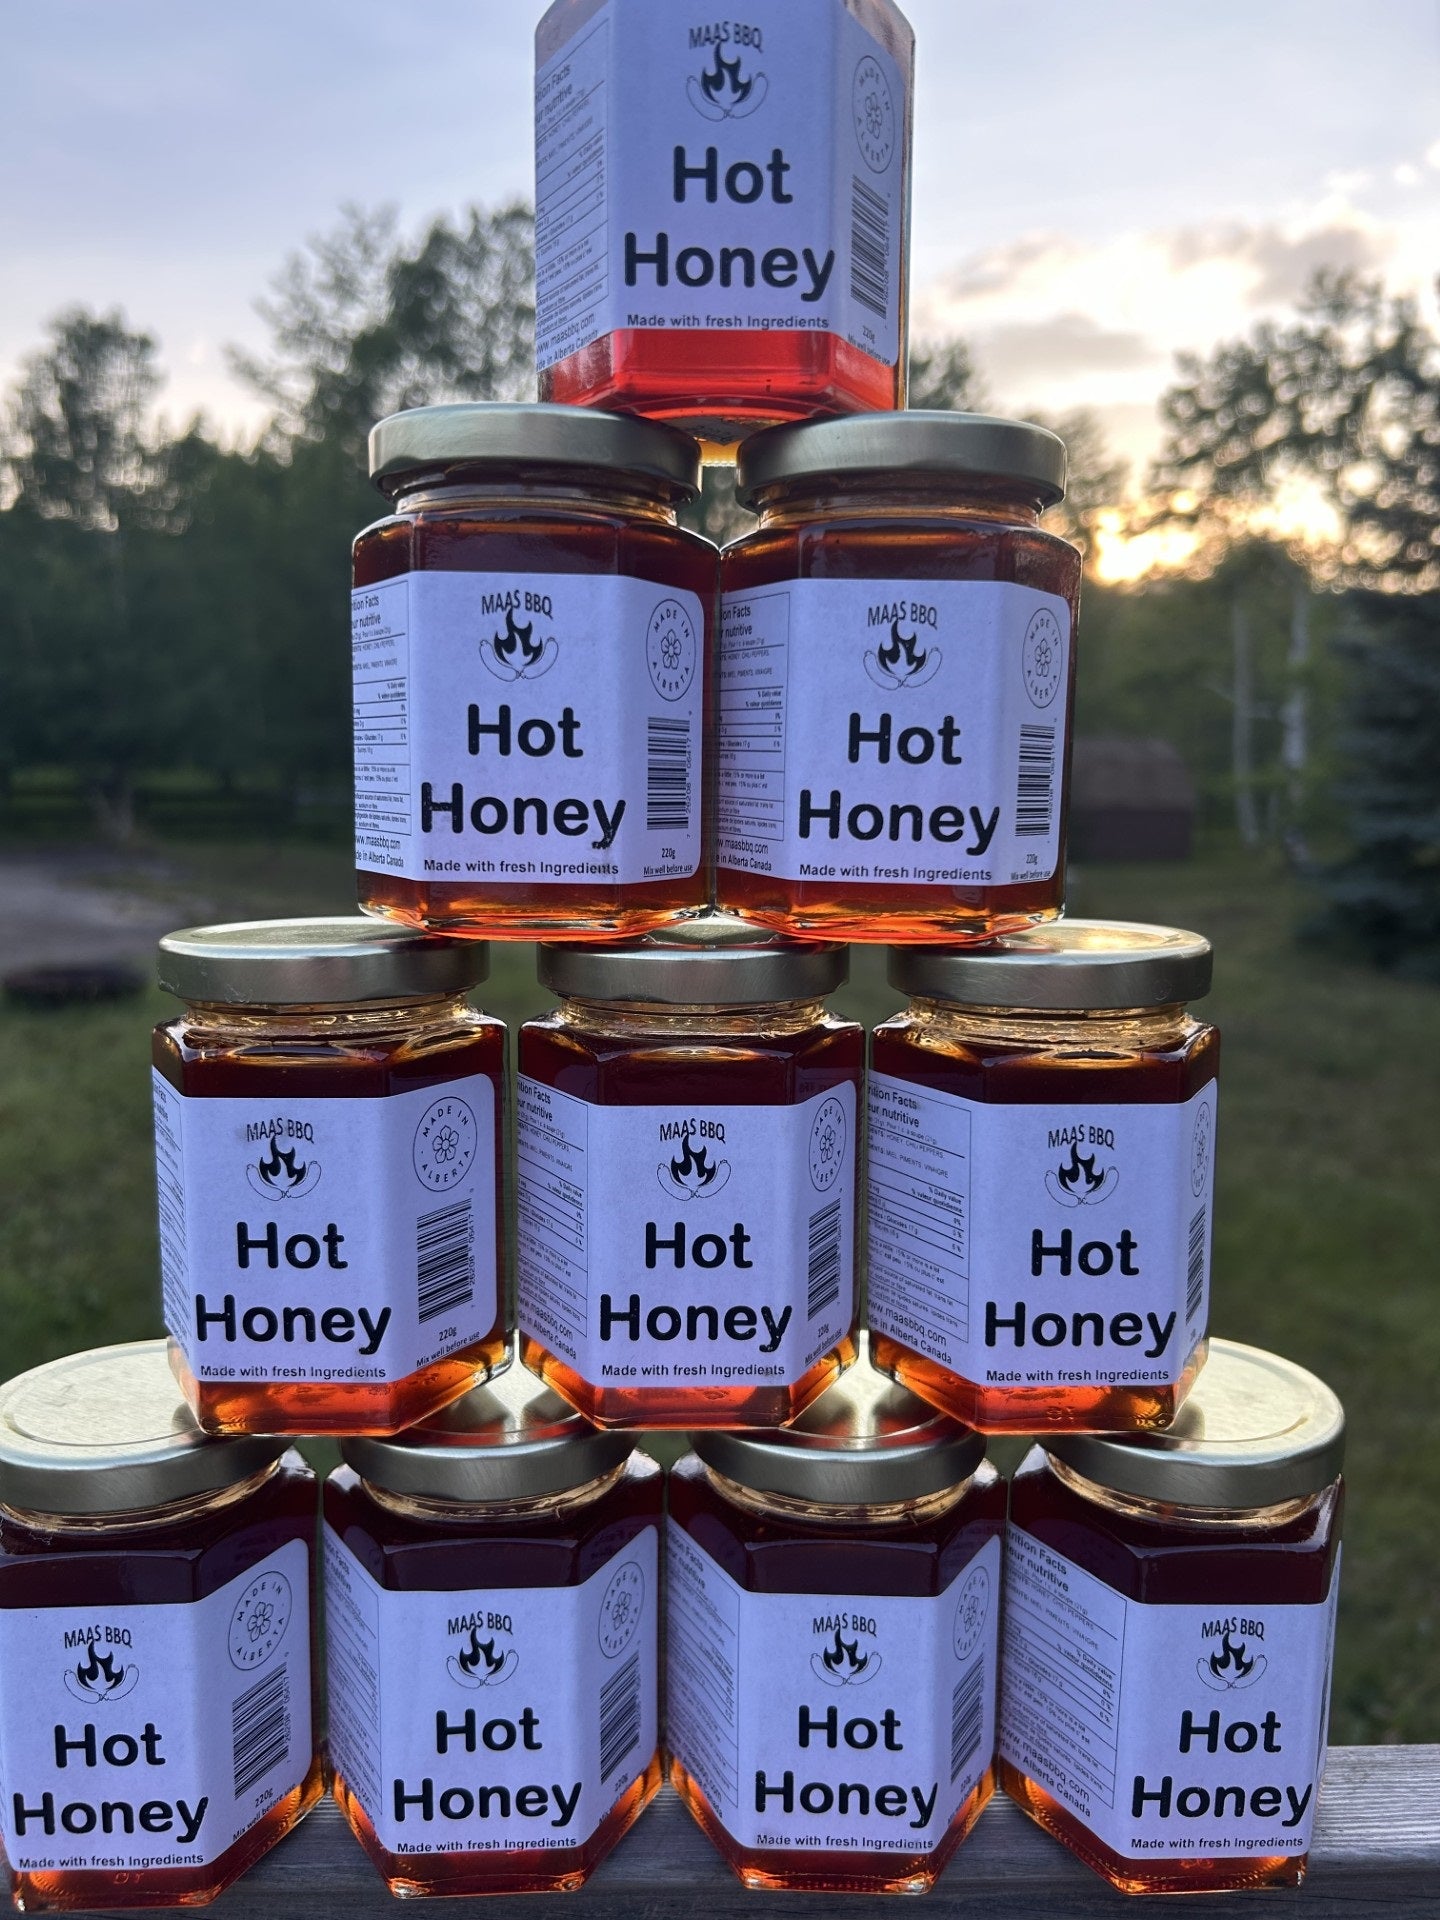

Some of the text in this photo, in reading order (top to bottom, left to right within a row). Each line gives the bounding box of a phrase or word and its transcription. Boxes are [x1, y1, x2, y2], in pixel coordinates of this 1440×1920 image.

[688, 20, 763, 53] MAAS BBQ
[674, 146, 793, 204] Hot
[625, 232, 835, 302] Honey
[627, 314, 830, 328] Made with fresh Ingredients
[481, 589, 554, 620] MAAS BBQ
[733, 605, 751, 618] Facts
[867, 600, 938, 630] MAAS BBQ
[654, 608, 677, 633] MADE
[725, 623, 753, 639] nutritive
[653, 662, 689, 692] ALBERTA
[468, 704, 583, 758] Hot
[848, 713, 962, 765] Hot
[421, 782, 626, 850] Honey
[799, 789, 1000, 856] Honey
[386, 853, 404, 868] Canada
[424, 860, 618, 876] Made with fresh Ingredients
[661, 848, 676, 859] 220g
[728, 855, 748, 868] Alberta
[749, 857, 772, 872] Canada
[800, 864, 993, 882] Made with fresh Ingredients
[892, 1091, 917, 1110] Facts
[246, 1117, 315, 1144] MAAS BBQ
[422, 1105, 469, 1138] MADE IN
[659, 1117, 727, 1144] MAAS BBQ
[881, 1108, 919, 1128] nutritive
[1048, 1124, 1116, 1150] MAAS BBQ
[422, 1150, 470, 1183] ALBERTA
[237, 1222, 348, 1269] Hot
[646, 1222, 753, 1268] Hot
[1032, 1229, 1139, 1276] Hot
[196, 1294, 391, 1355] Honey
[439, 1326, 457, 1342] 220g
[600, 1294, 792, 1352] Honey
[985, 1302, 1176, 1358] Honey
[416, 1331, 480, 1367] Mix well before use
[890, 1325, 919, 1347] Alberta
[920, 1340, 952, 1365] Canada
[201, 1366, 386, 1380] Made with fresh Ingredients
[602, 1364, 785, 1377] Made with fresh Ingredients
[987, 1369, 1169, 1383] Made with fresh Ingredients
[1027, 1558, 1069, 1592] nutritive
[1039, 1549, 1067, 1575] Facts
[237, 1581, 283, 1622] MADE IN
[64, 1624, 132, 1649] MAAS BBQ
[447, 1610, 514, 1636] MAAS BBQ
[812, 1613, 878, 1638] MAAS BBQ
[1201, 1616, 1265, 1641] MAAS BBQ
[236, 1617, 284, 1661] ALBERTA
[436, 1707, 542, 1754] Hot
[799, 1705, 903, 1751] Hot
[1179, 1710, 1281, 1753] Hot
[54, 1723, 165, 1768] Hot
[755, 1770, 938, 1828] Honey
[1023, 1755, 1055, 1787] Alberta
[1056, 1783, 1091, 1818] Canada
[1132, 1776, 1312, 1827] Honey
[13, 1792, 209, 1843] Honey
[394, 1778, 582, 1827] Honey
[398, 1838, 577, 1852] Made with fresh Ingredients
[757, 1834, 934, 1850] Made with fresh Ingredients
[1131, 1838, 1303, 1849] Made with fresh Ingredients
[19, 1854, 203, 1868] Made with fresh Ingredients
